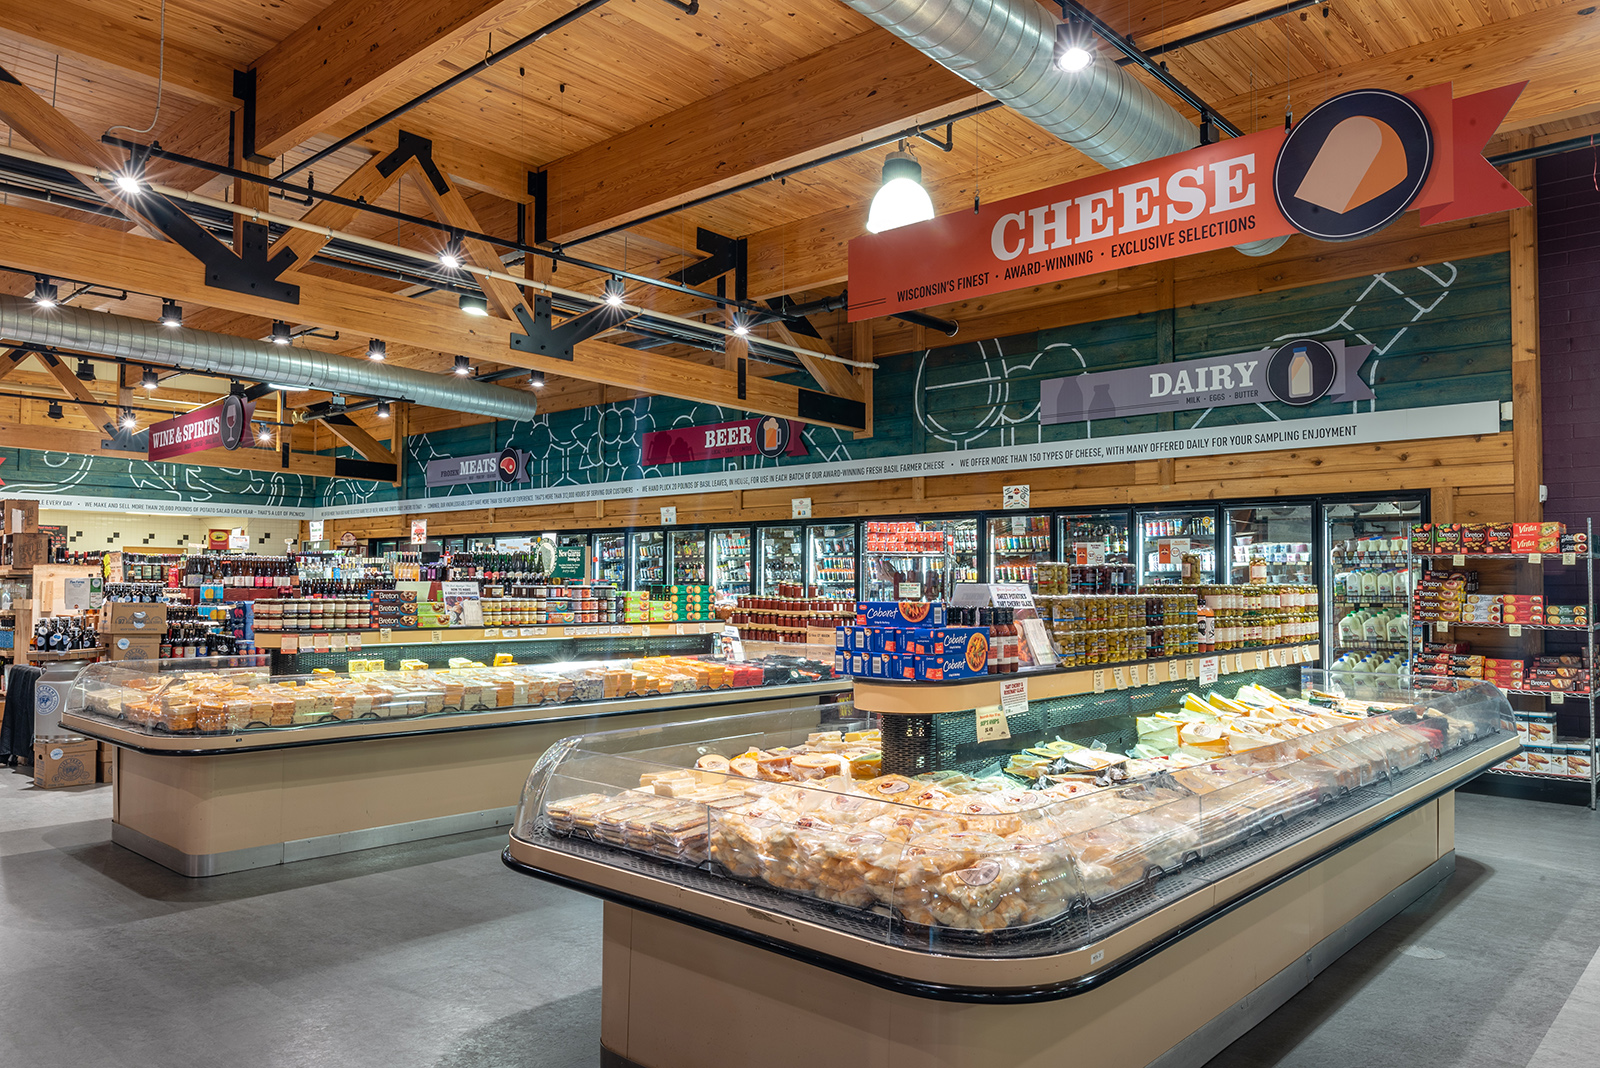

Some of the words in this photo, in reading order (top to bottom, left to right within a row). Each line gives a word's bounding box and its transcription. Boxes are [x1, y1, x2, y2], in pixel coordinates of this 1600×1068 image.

[991, 153, 1255, 261] CHEESE
[897, 282, 955, 302] WISCONSIN'S
[957, 272, 990, 291] FINEST
[1004, 250, 1093, 280] AWARD-WINNING
[1111, 232, 1175, 258] EXCLUSIVE
[1178, 215, 1256, 244] SELECTIONS
[1150, 361, 1258, 398] DAIRY
[1186, 396, 1201, 405] MILK
[1209, 394, 1225, 402] EGGS
[1234, 390, 1259, 399] BUTTER
[153, 428, 175, 449] WINE
[175, 427, 182, 444] &
[183, 416, 220, 442] SPIRITS
[705, 426, 752, 448] BEER
[960, 459, 969, 467] WE
[971, 457, 990, 467] OFFER
[991, 455, 1008, 465] MORE
[1010, 454, 1028, 463] THAN
[1029, 452, 1041, 462] 150
[1042, 450, 1064, 461] TYPES
[1065, 449, 1074, 459] OF
[1075, 447, 1104, 459] CHEESE,
[1105, 445, 1124, 456] WITH
[1126, 443, 1149, 455] MANY
[1150, 440, 1184, 453] OFFERED
[1186, 437, 1209, 450] DAILY
[1212, 436, 1228, 448] FOR
[1229, 434, 1252, 446] YOUR
[1254, 430, 1299, 444] SAMPLING
[1302, 425, 1357, 441] ENJOYMENT
[460, 458, 497, 475] MEATS
[677, 482, 693, 490] POUNDS
[750, 476, 759, 484] FOR
[760, 475, 769, 483] USE
[775, 474, 787, 482] EACH
[788, 472, 804, 481] BATCH
[812, 471, 822, 479] OUR
[823, 468, 865, 478] AWARD-WINNING
[866, 466, 882, 475] FRESH
[884, 465, 899, 474] BASIL
[900, 462, 922, 472] FARMER
[923, 460, 945, 470] CHEESE
[1490, 530, 1511, 538] Breton
[1519, 524, 1537, 533] Vinta
[1439, 531, 1458, 539] Breton
[1465, 531, 1484, 539] Breton
[1516, 540, 1535, 549] Vinta
[379, 592, 399, 600] Breton
[378, 604, 399, 612] Breton
[867, 607, 898, 619] Cabaret
[378, 616, 399, 624] Breton
[944, 634, 967, 646] Cabaret
[943, 659, 966, 672] Cabaret
